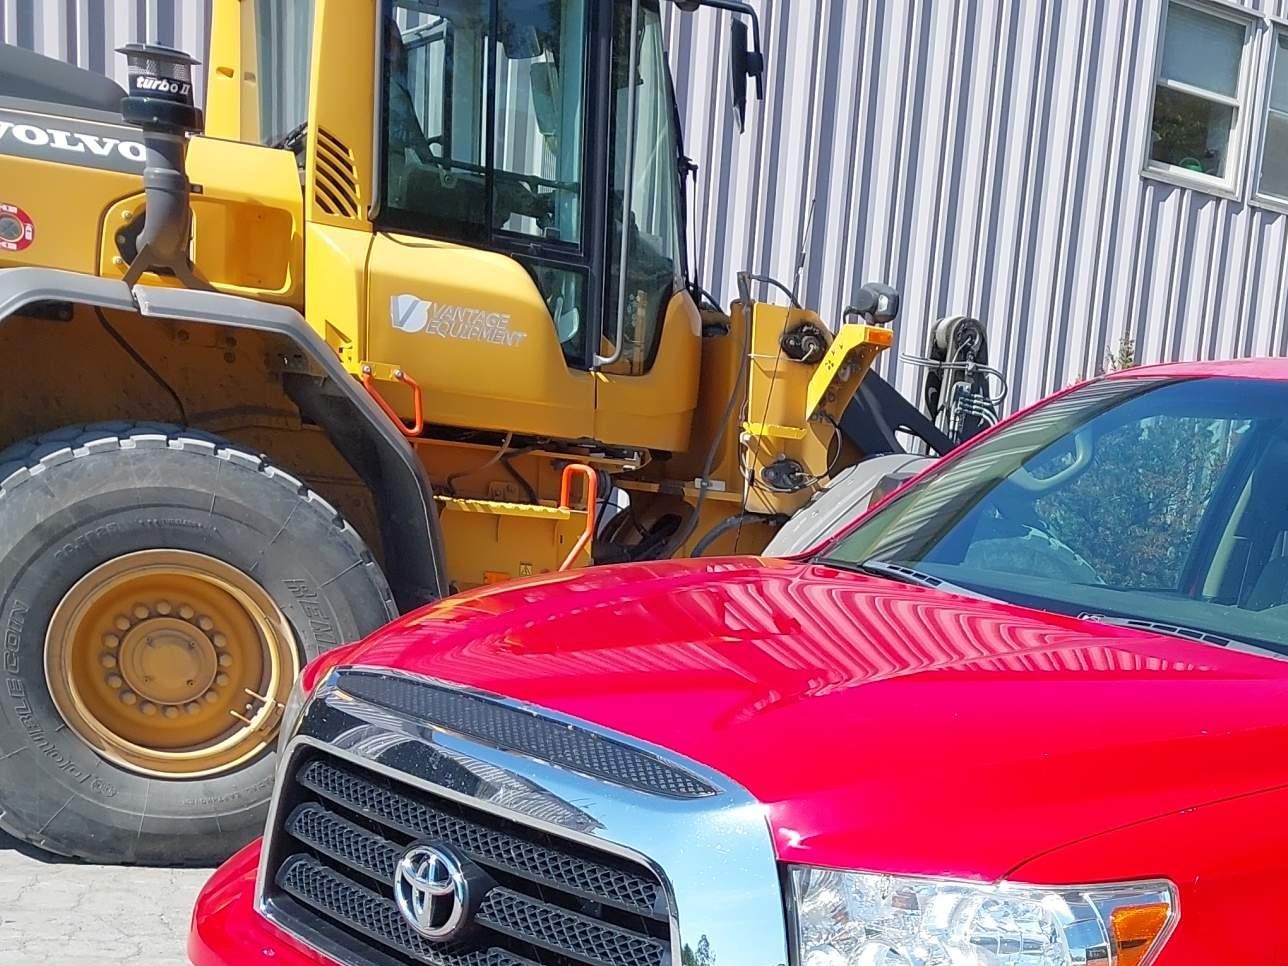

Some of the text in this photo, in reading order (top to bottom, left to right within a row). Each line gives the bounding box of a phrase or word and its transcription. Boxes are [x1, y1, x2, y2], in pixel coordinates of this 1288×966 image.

[136, 75, 178, 93] turbo
[432, 303, 511, 328] VANTAGE
[425, 319, 528, 347] EQUIPMENT
[4, 600, 30, 674] COIN
